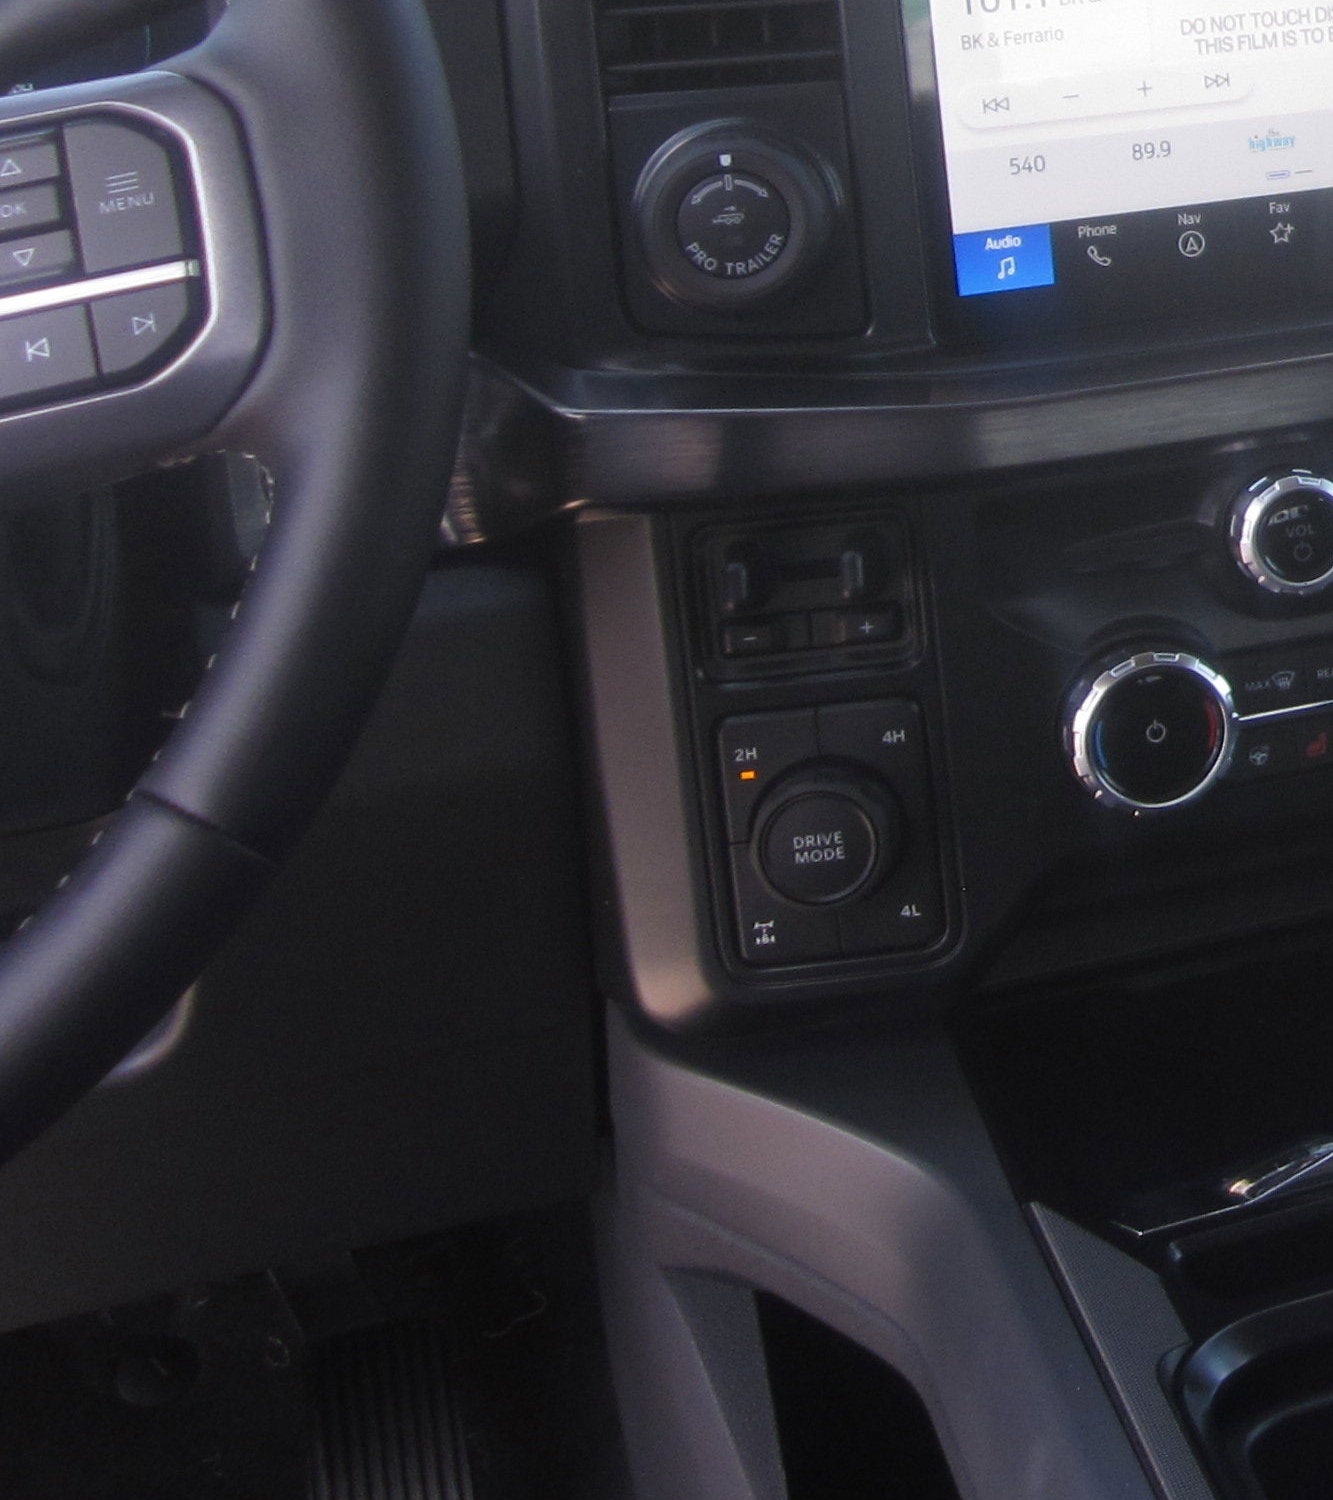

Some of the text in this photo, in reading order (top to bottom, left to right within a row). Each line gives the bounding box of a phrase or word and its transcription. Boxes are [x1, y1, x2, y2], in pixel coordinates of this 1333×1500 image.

[1180, 18, 1205, 36] DO
[1210, 13, 1246, 33] NOT
[1249, 8, 1310, 28] TOUCH
[960, 27, 1064, 51] BK & Ferrario
[1195, 35, 1234, 55] THIS
[1237, 31, 1278, 51] FILM
[1282, 29, 1298, 46] IS
[1300, 26, 1325, 45] TO
[1131, 140, 1172, 161] 89.9
[1009, 155, 1046, 176] 540
[98, 191, 157, 215] MENU
[1269, 201, 1290, 215] Fav
[1178, 213, 1201, 226] Nav
[1078, 222, 1117, 239] Phone
[985, 235, 1022, 251] Audio
[685, 233, 785, 277] PRO TRAILER
[1286, 522, 1316, 539] VOL
[1243, 678, 1272, 693] MAX
[881, 728, 906, 746] 4H
[733, 746, 758, 764] 2H
[792, 830, 845, 850] DRIVE
[793, 845, 846, 865] MODE
[899, 903, 921, 919] 4L
